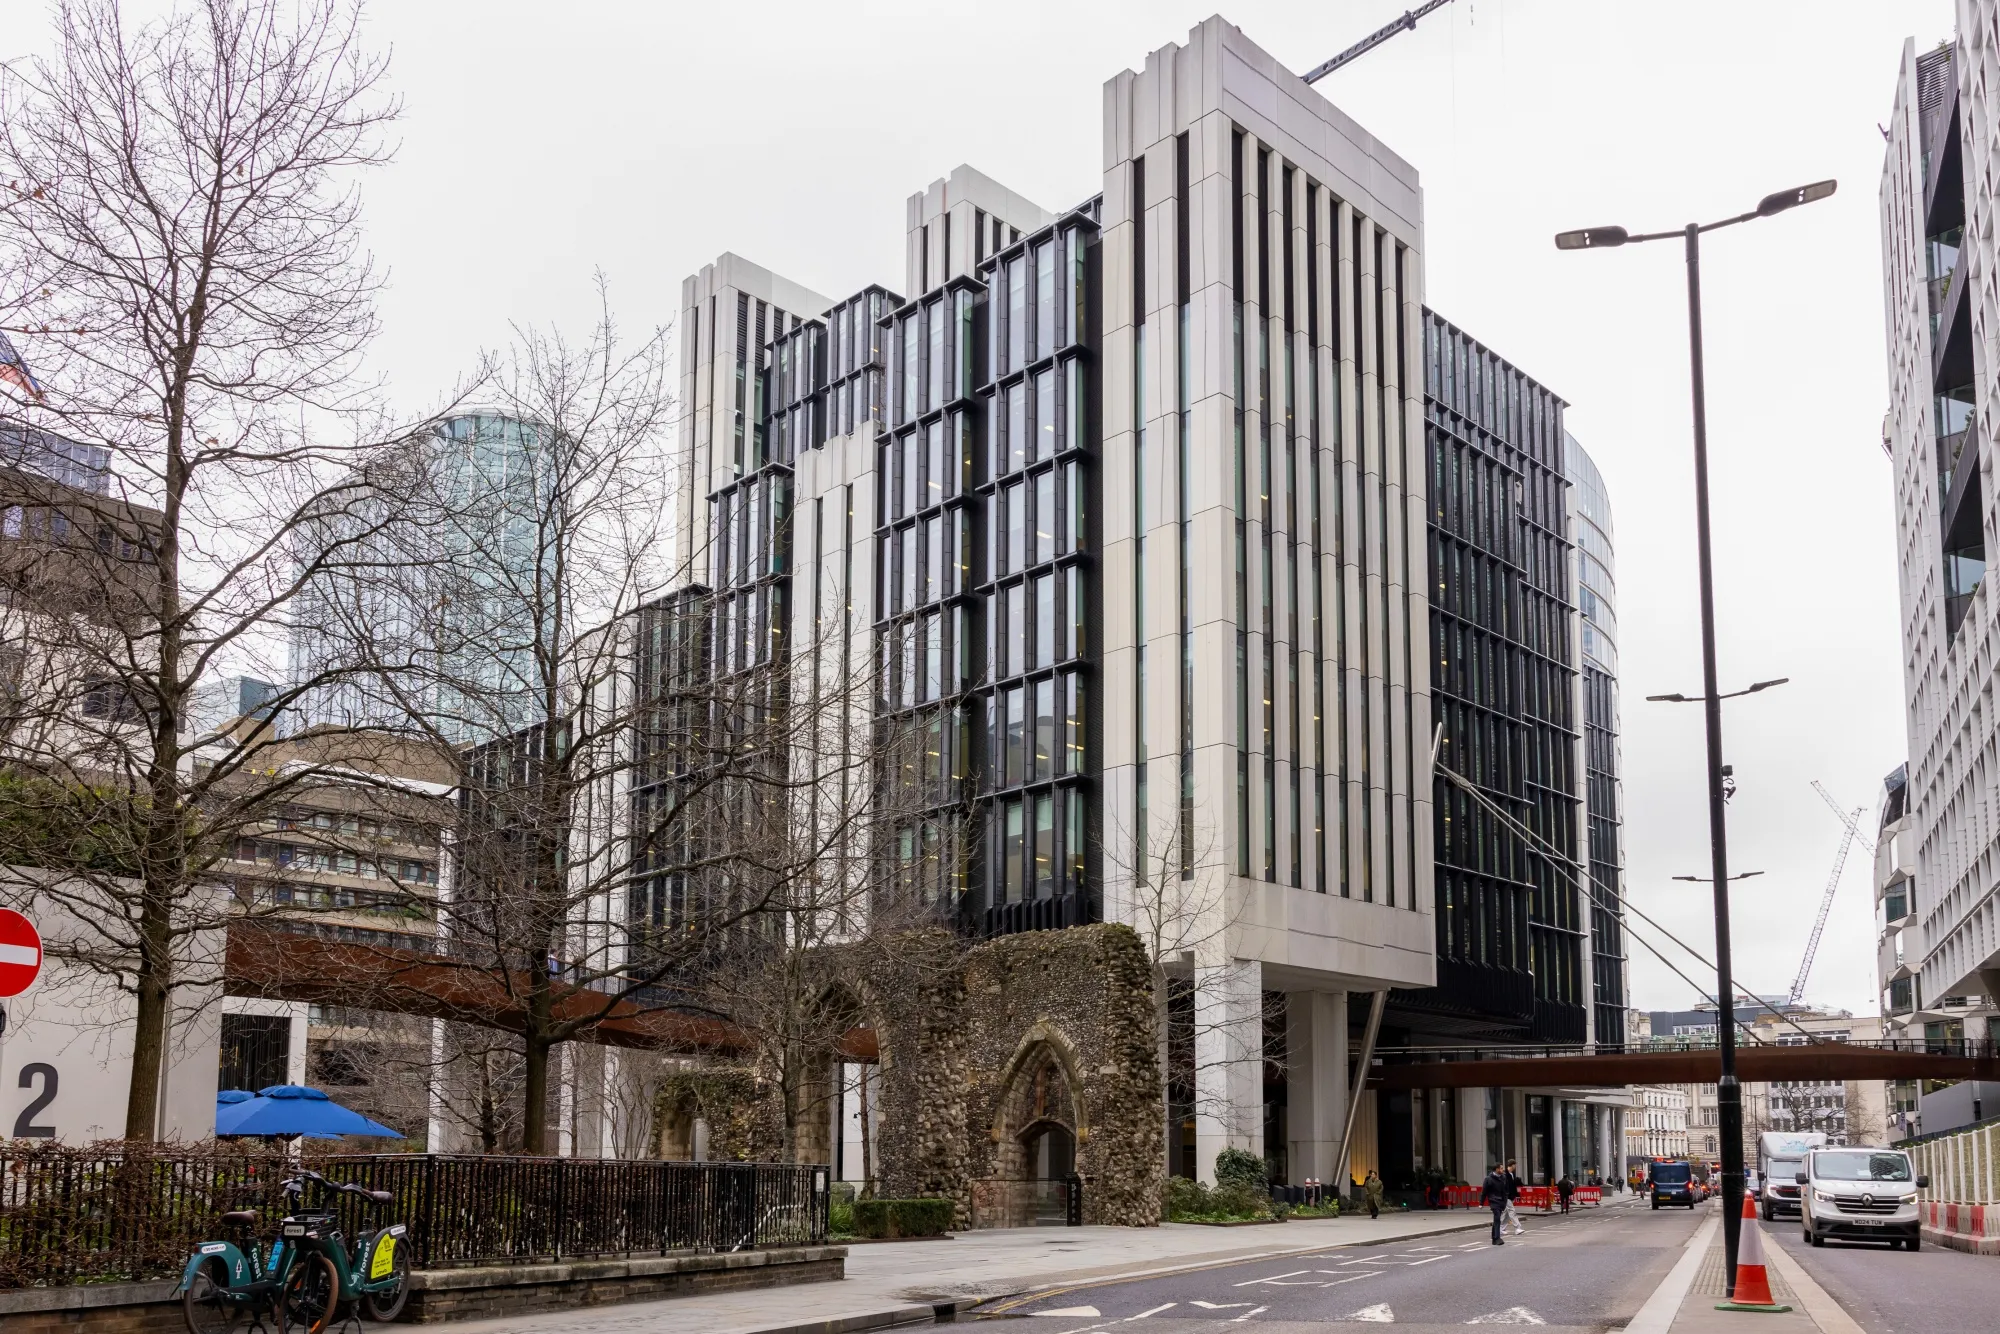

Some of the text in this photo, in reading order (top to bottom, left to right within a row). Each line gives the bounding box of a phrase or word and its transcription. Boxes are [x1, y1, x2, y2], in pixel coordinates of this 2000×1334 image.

[13, 1062, 58, 1137] 2
[251, 1247, 262, 1279] forest
[360, 1241, 370, 1273] forest
